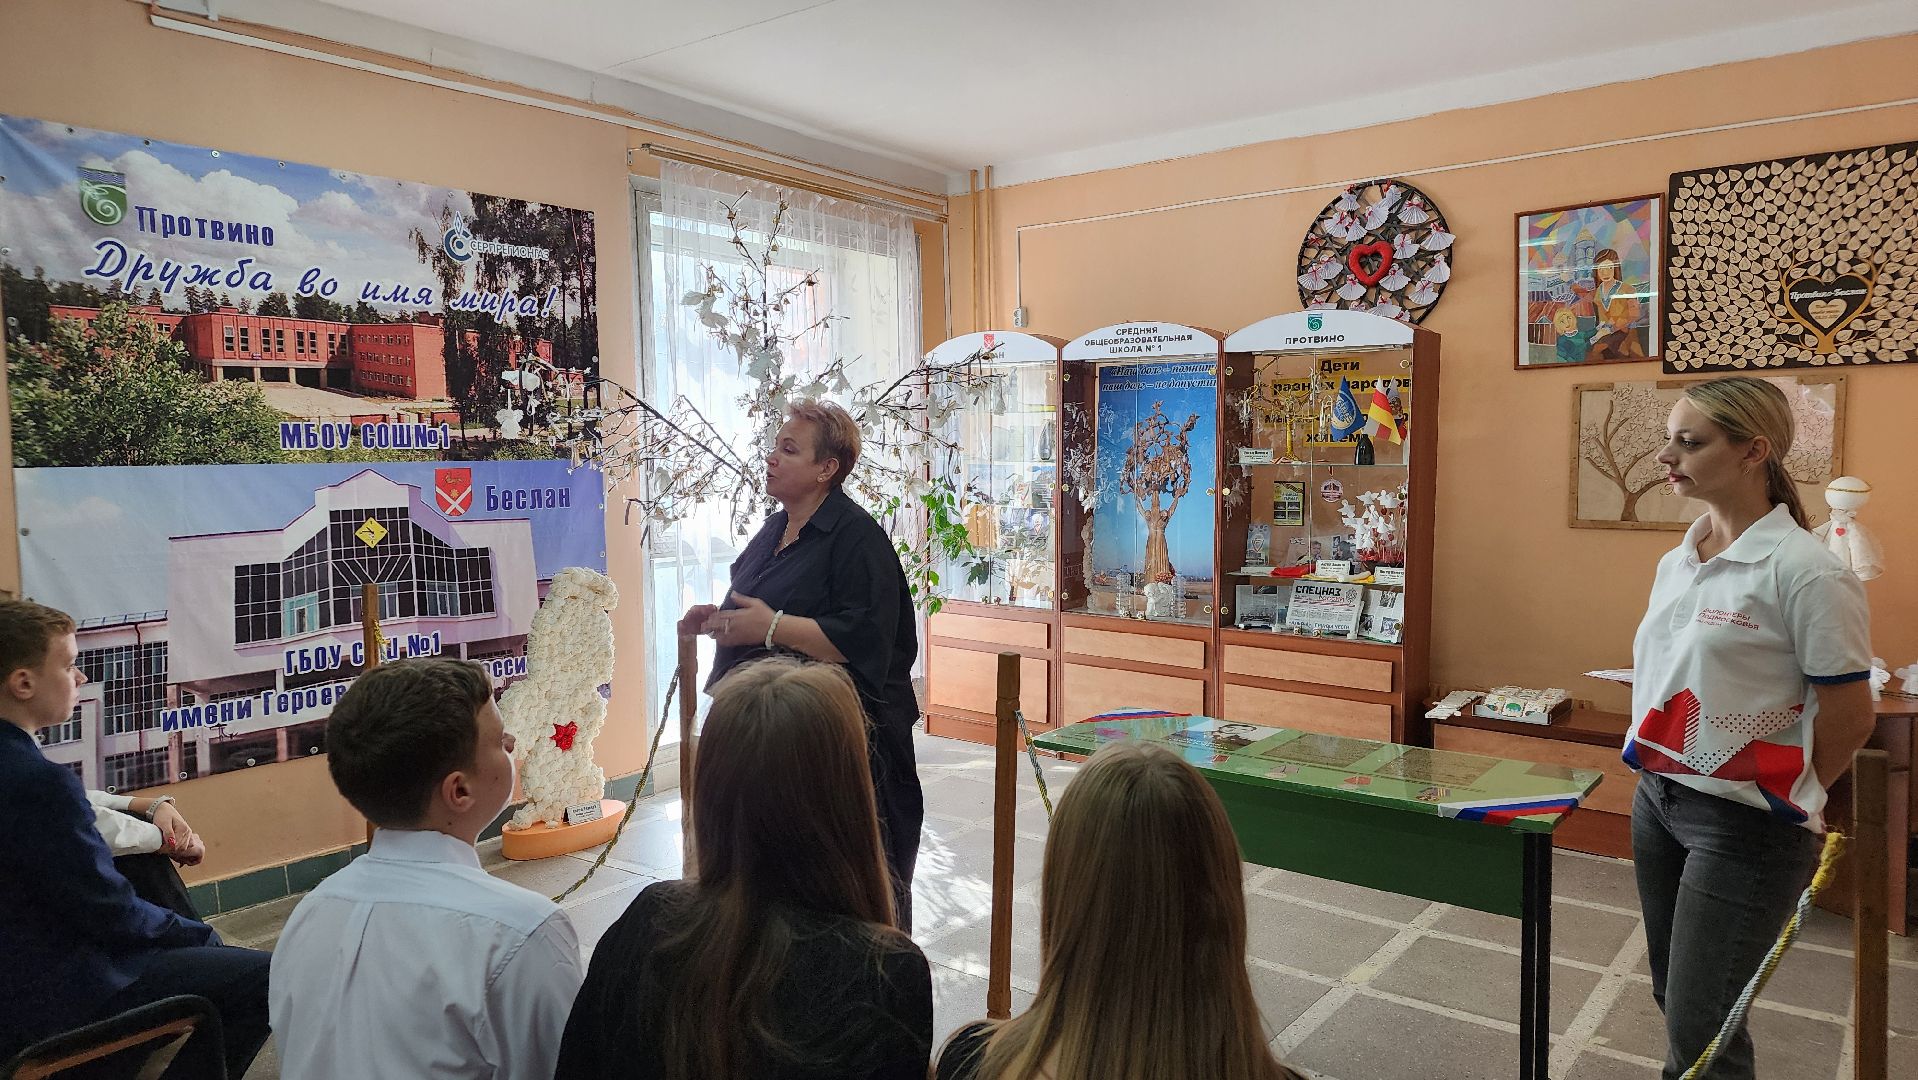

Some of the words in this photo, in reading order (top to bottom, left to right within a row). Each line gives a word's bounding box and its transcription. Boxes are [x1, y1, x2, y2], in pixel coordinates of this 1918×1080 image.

[135, 205, 274, 247] Протвино
[470, 241, 549, 259] СЕРПРЕГИОНГАЗ
[85, 240, 272, 294] Дружба
[298, 268, 338, 296] во
[361, 281, 432, 306] имя
[452, 288, 557, 321] мира!
[1116, 327, 1158, 336] СРЕДНЯЯ
[1084, 334, 1193, 346] ОБЩЕОБРАЗОВАТЕЛЬНАЯ
[1285, 335, 1345, 344] ПРОТВИНО
[1109, 345, 1143, 354] ШКОЛА
[1140, 365, 1162, 376] долг
[1320, 360, 1360, 372] Дети
[1155, 380, 1168, 390] не
[1168, 378, 1217, 390] допусти
[1273, 381, 1335, 395] разнх
[281, 423, 351, 450] МБОУ
[486, 485, 570, 511] Беслан
[1296, 585, 1341, 596] СПЕЦНАЗ
[285, 644, 342, 674] ГБОУ
[352, 637, 398, 664] СШ
[407, 632, 440, 657] №1
[162, 699, 252, 732] имени
[263, 685, 347, 715] Героев
